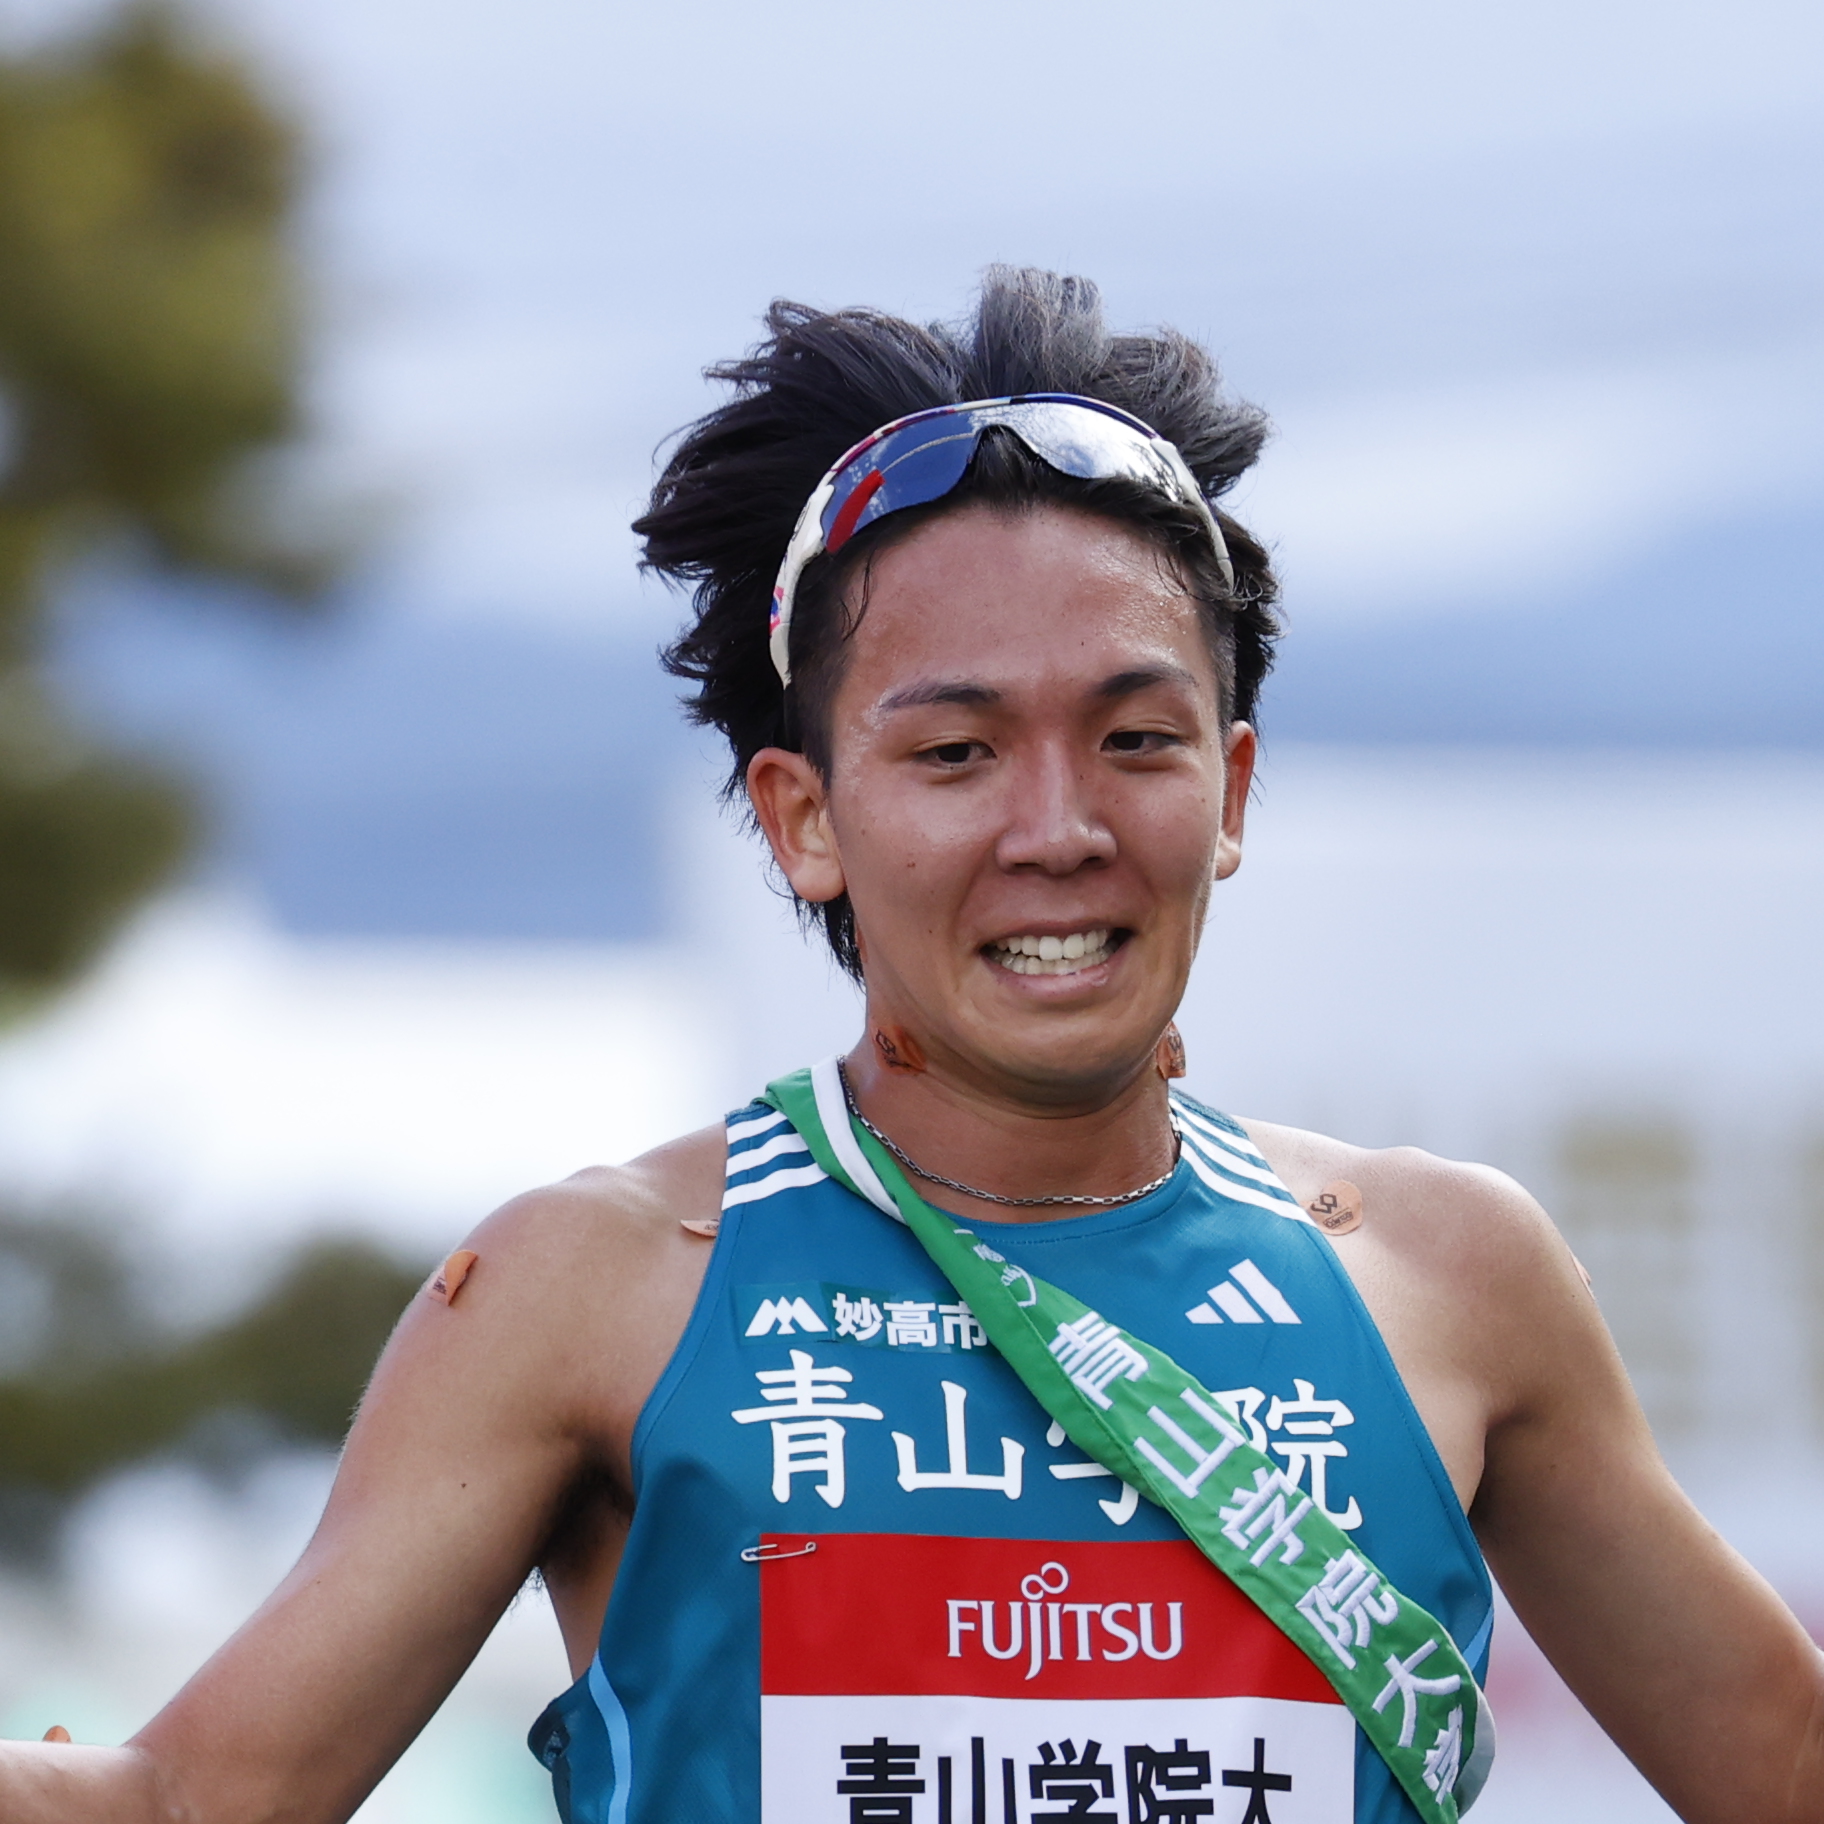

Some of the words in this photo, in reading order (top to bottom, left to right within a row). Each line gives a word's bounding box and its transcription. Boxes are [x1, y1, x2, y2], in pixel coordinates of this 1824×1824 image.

[831, 1291, 988, 1350] 妙高市
[945, 1561, 1183, 1680] FUJITSU
